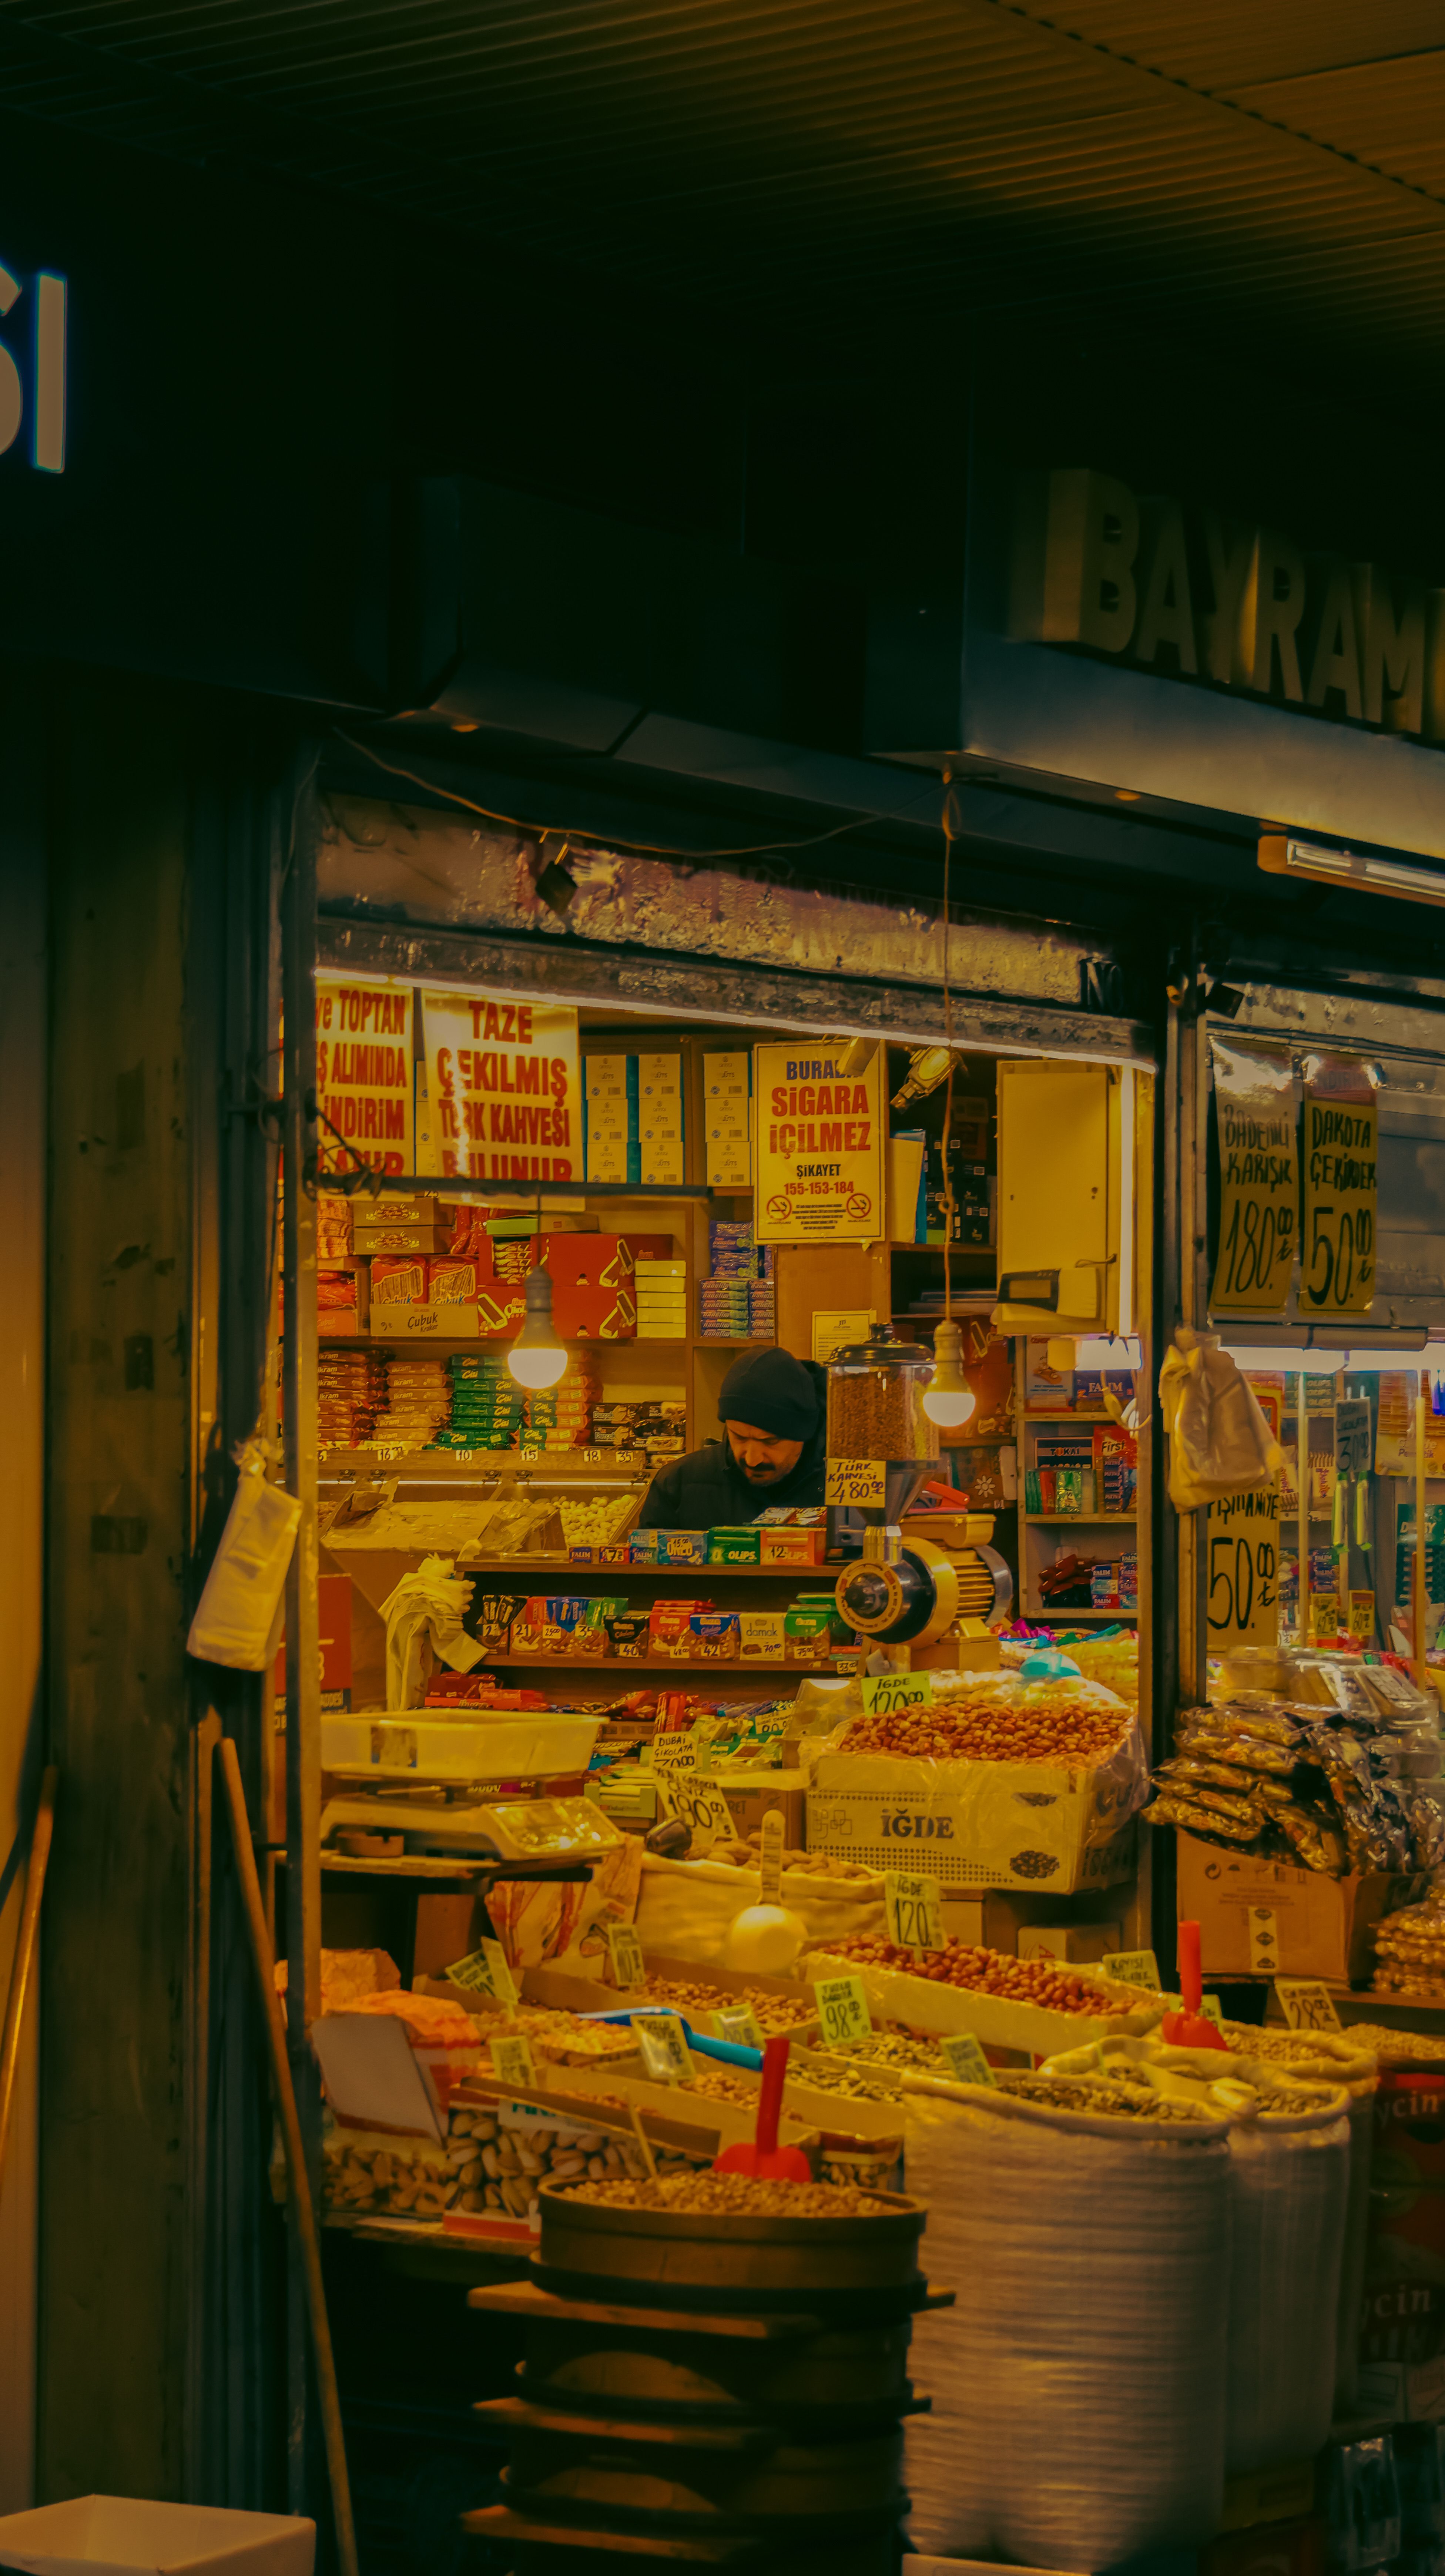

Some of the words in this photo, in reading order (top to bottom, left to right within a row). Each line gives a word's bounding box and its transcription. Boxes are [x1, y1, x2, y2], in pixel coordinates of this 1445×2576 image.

[1044, 468, 1445, 742] BAYRAM
[339, 990, 405, 1035] TOPTAN
[469, 1000, 533, 1044] TAZE
[331, 1043, 407, 1088] ALIMINDA
[772, 1084, 869, 1117] SİGARA
[1312, 1107, 1371, 1150] DAKOTA
[769, 1121, 871, 1159] İÇİLMEZ
[796, 1164, 841, 1179] ŞİKAYET
[784, 1181, 854, 1195] 155-153-184
[1088, 1382, 1123, 1392] FAIM
[1050, 1447, 1080, 1456] TOKAI
[1101, 1439, 1126, 1453] First
[524, 1451, 536, 1460] 15
[618, 1451, 631, 1462] 35
[834, 1459, 874, 1473] TÜRK
[746, 1623, 778, 1636] damak
[703, 1646, 719, 1657] 42
[881, 1808, 955, 1839] İĞDE
